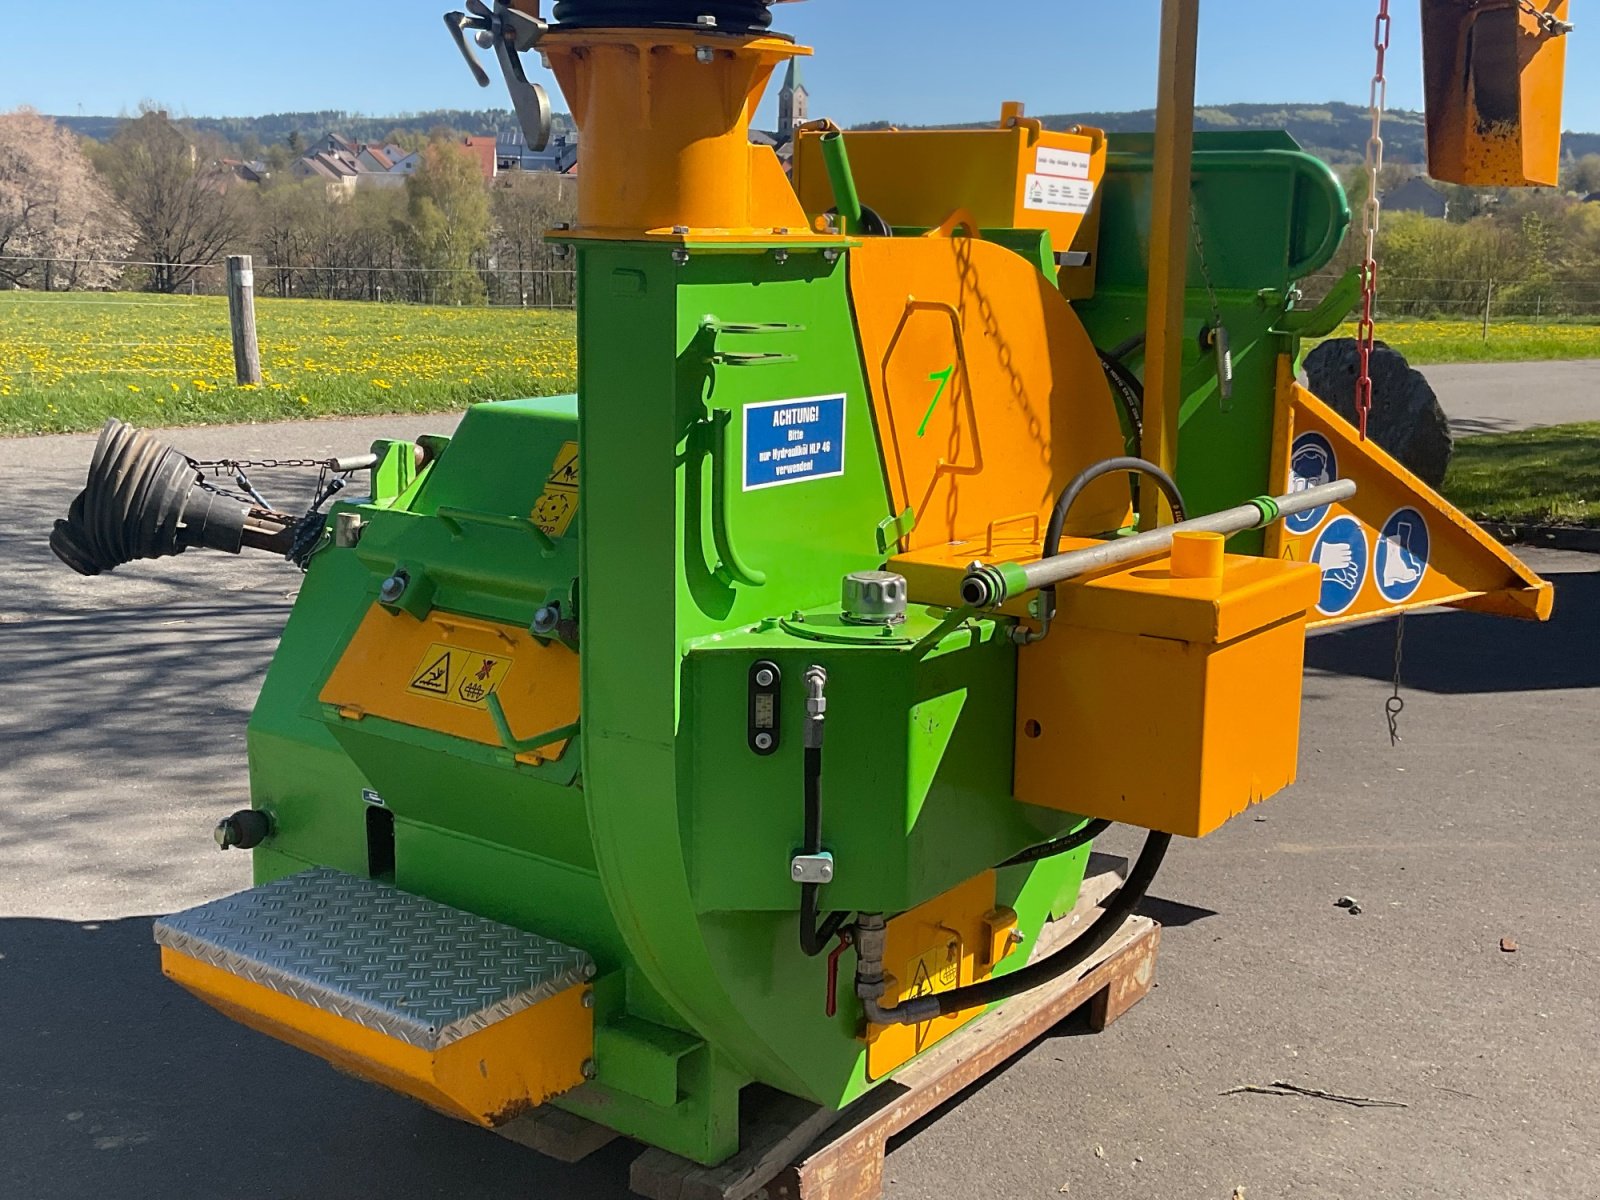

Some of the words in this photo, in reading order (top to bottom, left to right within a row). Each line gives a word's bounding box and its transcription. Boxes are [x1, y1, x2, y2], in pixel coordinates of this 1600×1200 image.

[772, 405, 819, 427] ACHTUNG!
[787, 429, 804, 441] Bitte
[759, 451, 771, 462] nur
[772, 444, 808, 461] Hydrauliköl
[809, 443, 821, 455] HLP
[821, 441, 831, 452] 46
[775, 460, 813, 476] verwenden!
